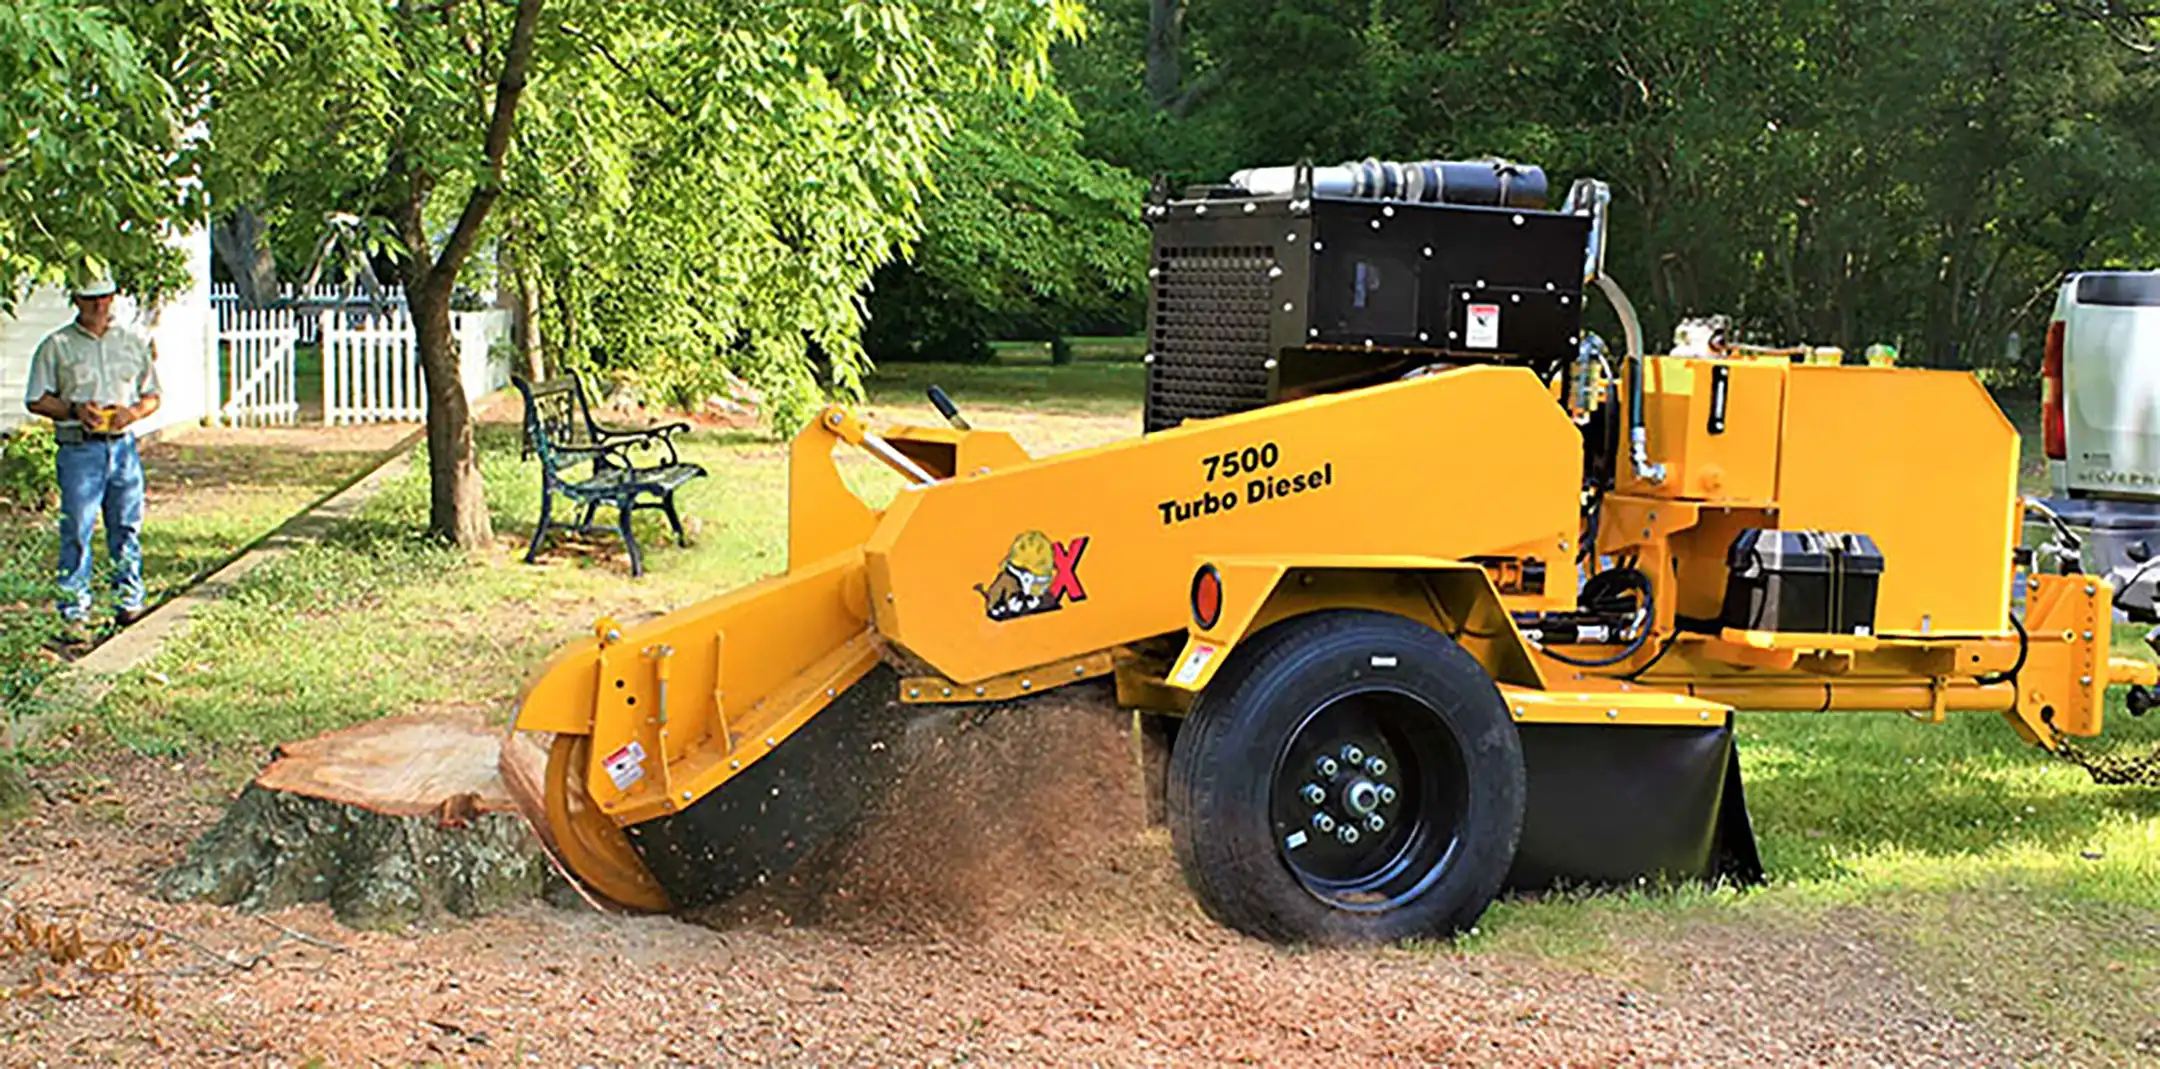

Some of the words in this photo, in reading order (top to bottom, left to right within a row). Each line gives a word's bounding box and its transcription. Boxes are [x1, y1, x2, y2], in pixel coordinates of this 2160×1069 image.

[1158, 492, 1238, 525] Turbo
[1247, 462, 1332, 504] Diesel
[1202, 442, 1279, 482] 7500
[1051, 536, 1090, 602] X
